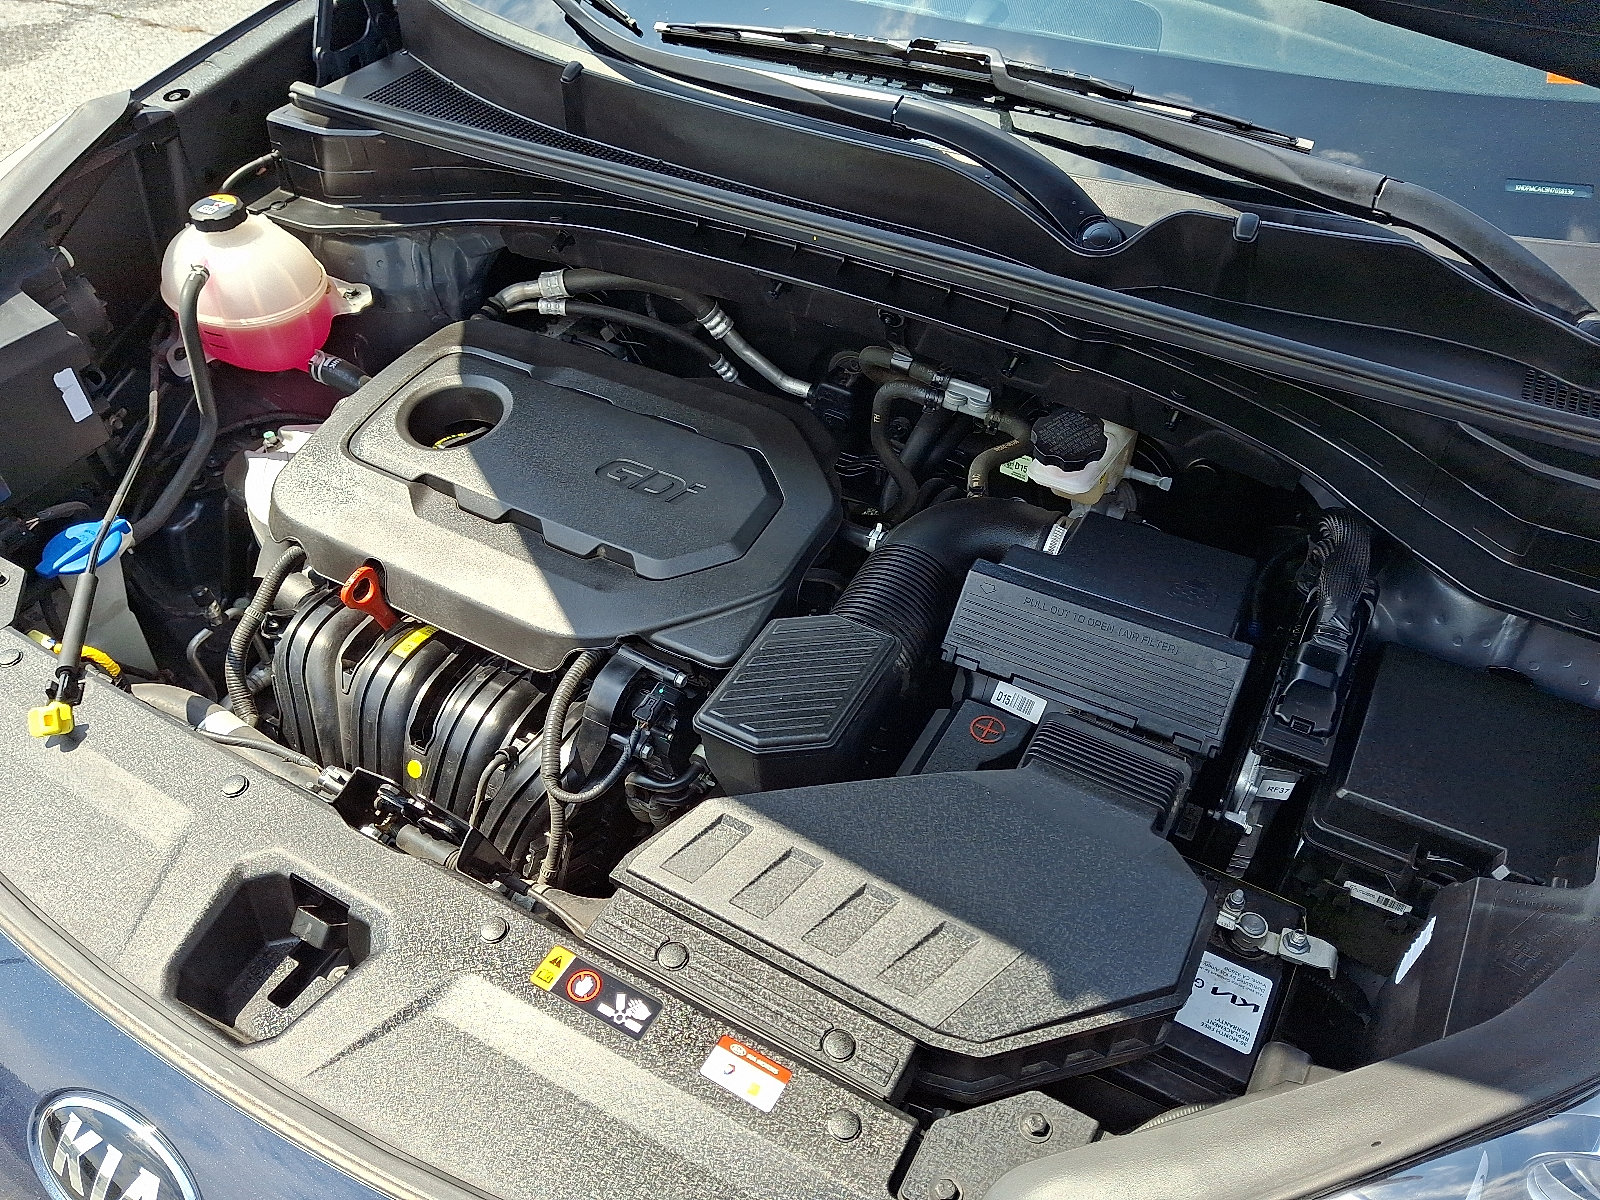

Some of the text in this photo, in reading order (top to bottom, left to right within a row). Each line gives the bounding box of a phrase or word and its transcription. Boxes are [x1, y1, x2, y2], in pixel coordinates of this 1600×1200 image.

[1014, 461, 1029, 473] D15
[1023, 596, 1179, 655] PULL OUT TO OPEN (AIR FILTER)
[995, 690, 1012, 706] D15
[1266, 785, 1291, 794] RF37
[1206, 1018, 1250, 1042] REPLACEMENT
[52, 1111, 161, 1200] KIA
